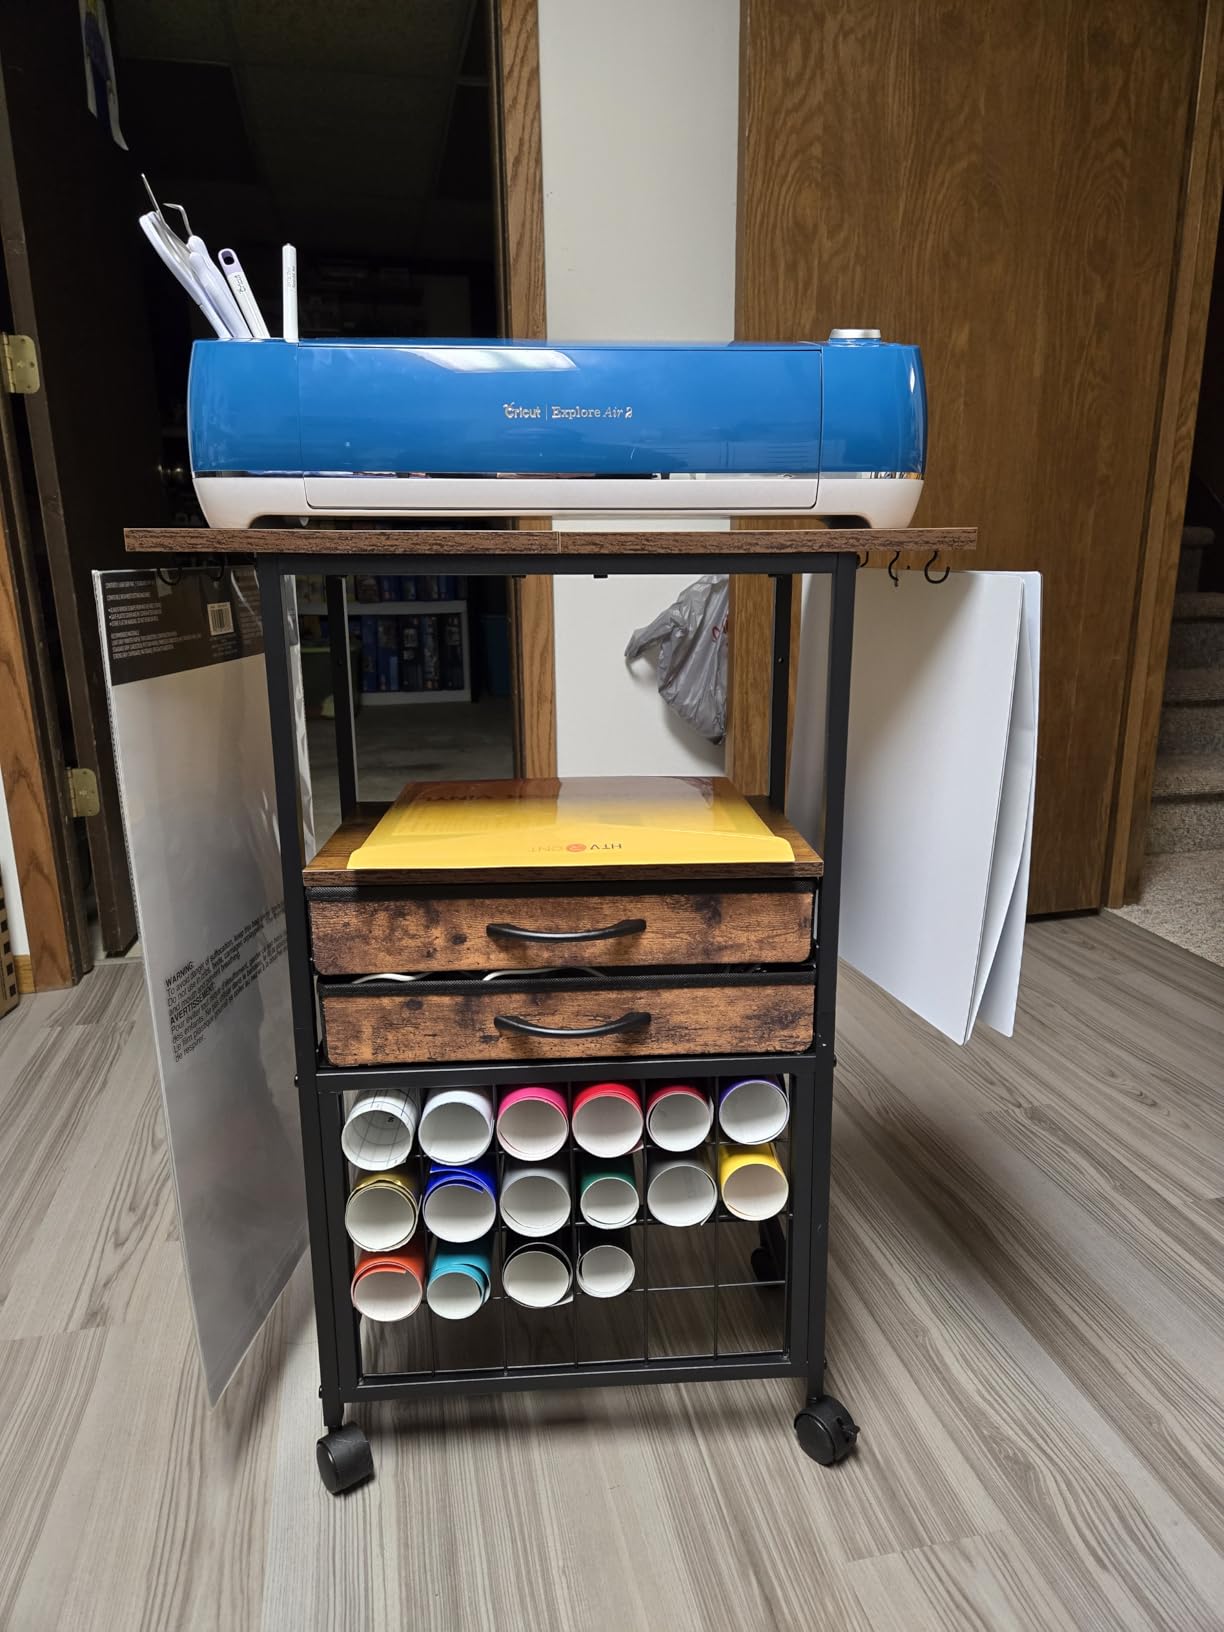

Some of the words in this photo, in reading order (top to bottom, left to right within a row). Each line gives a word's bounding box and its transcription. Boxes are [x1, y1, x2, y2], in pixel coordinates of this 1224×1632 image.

[502, 402, 541, 419] Cricut
[551, 405, 601, 420] Explore
[603, 406, 624, 418] Air
[624, 406, 633, 419] 2
